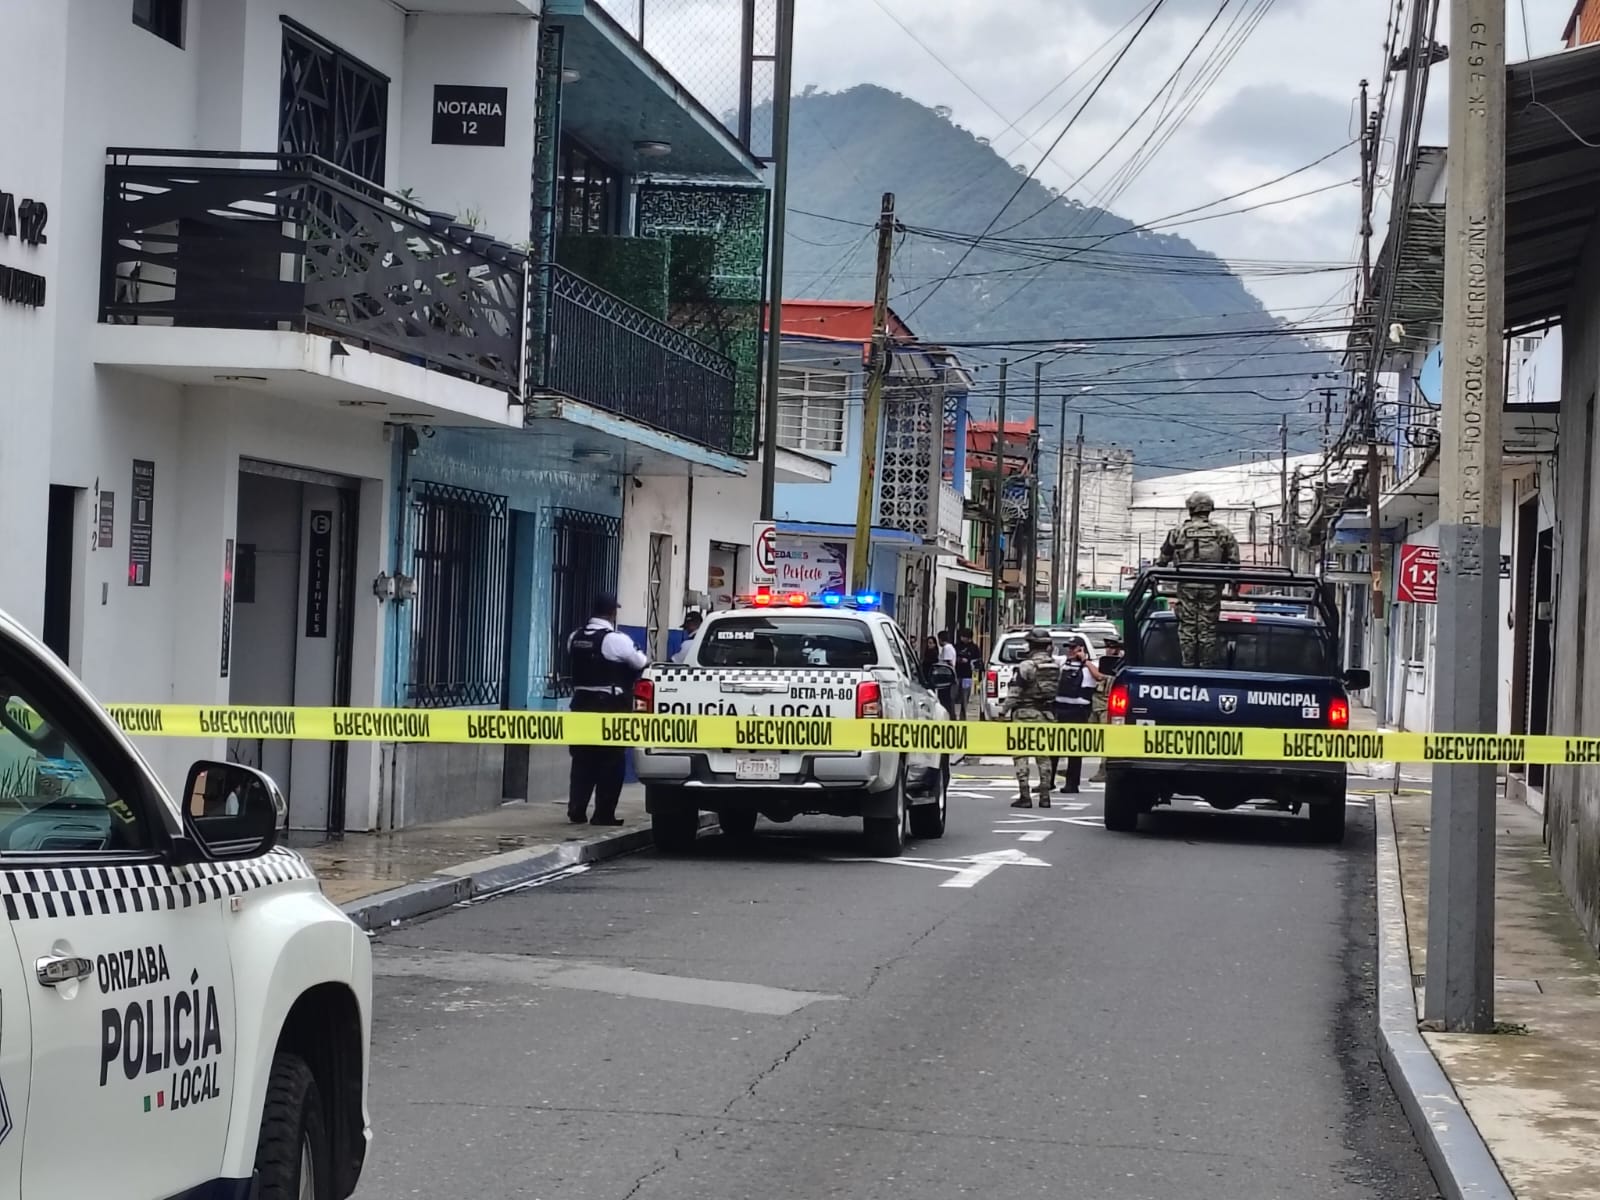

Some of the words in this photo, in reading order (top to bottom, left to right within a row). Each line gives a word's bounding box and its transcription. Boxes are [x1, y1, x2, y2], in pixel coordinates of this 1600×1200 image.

[437, 101, 502, 116] NOTARIA
[461, 121, 478, 135] 12
[313, 548, 324, 633] CLIENTES
[790, 687, 853, 701] BETA-PA-80
[1138, 684, 1210, 703] POLICÍA
[1247, 690, 1320, 708] MUNICIPAL
[657, 699, 738, 718] POLICÍA
[97, 944, 170, 994] ORIZABA
[99, 968, 222, 1087] POLICÍA
[170, 1062, 220, 1111] LOCAL
